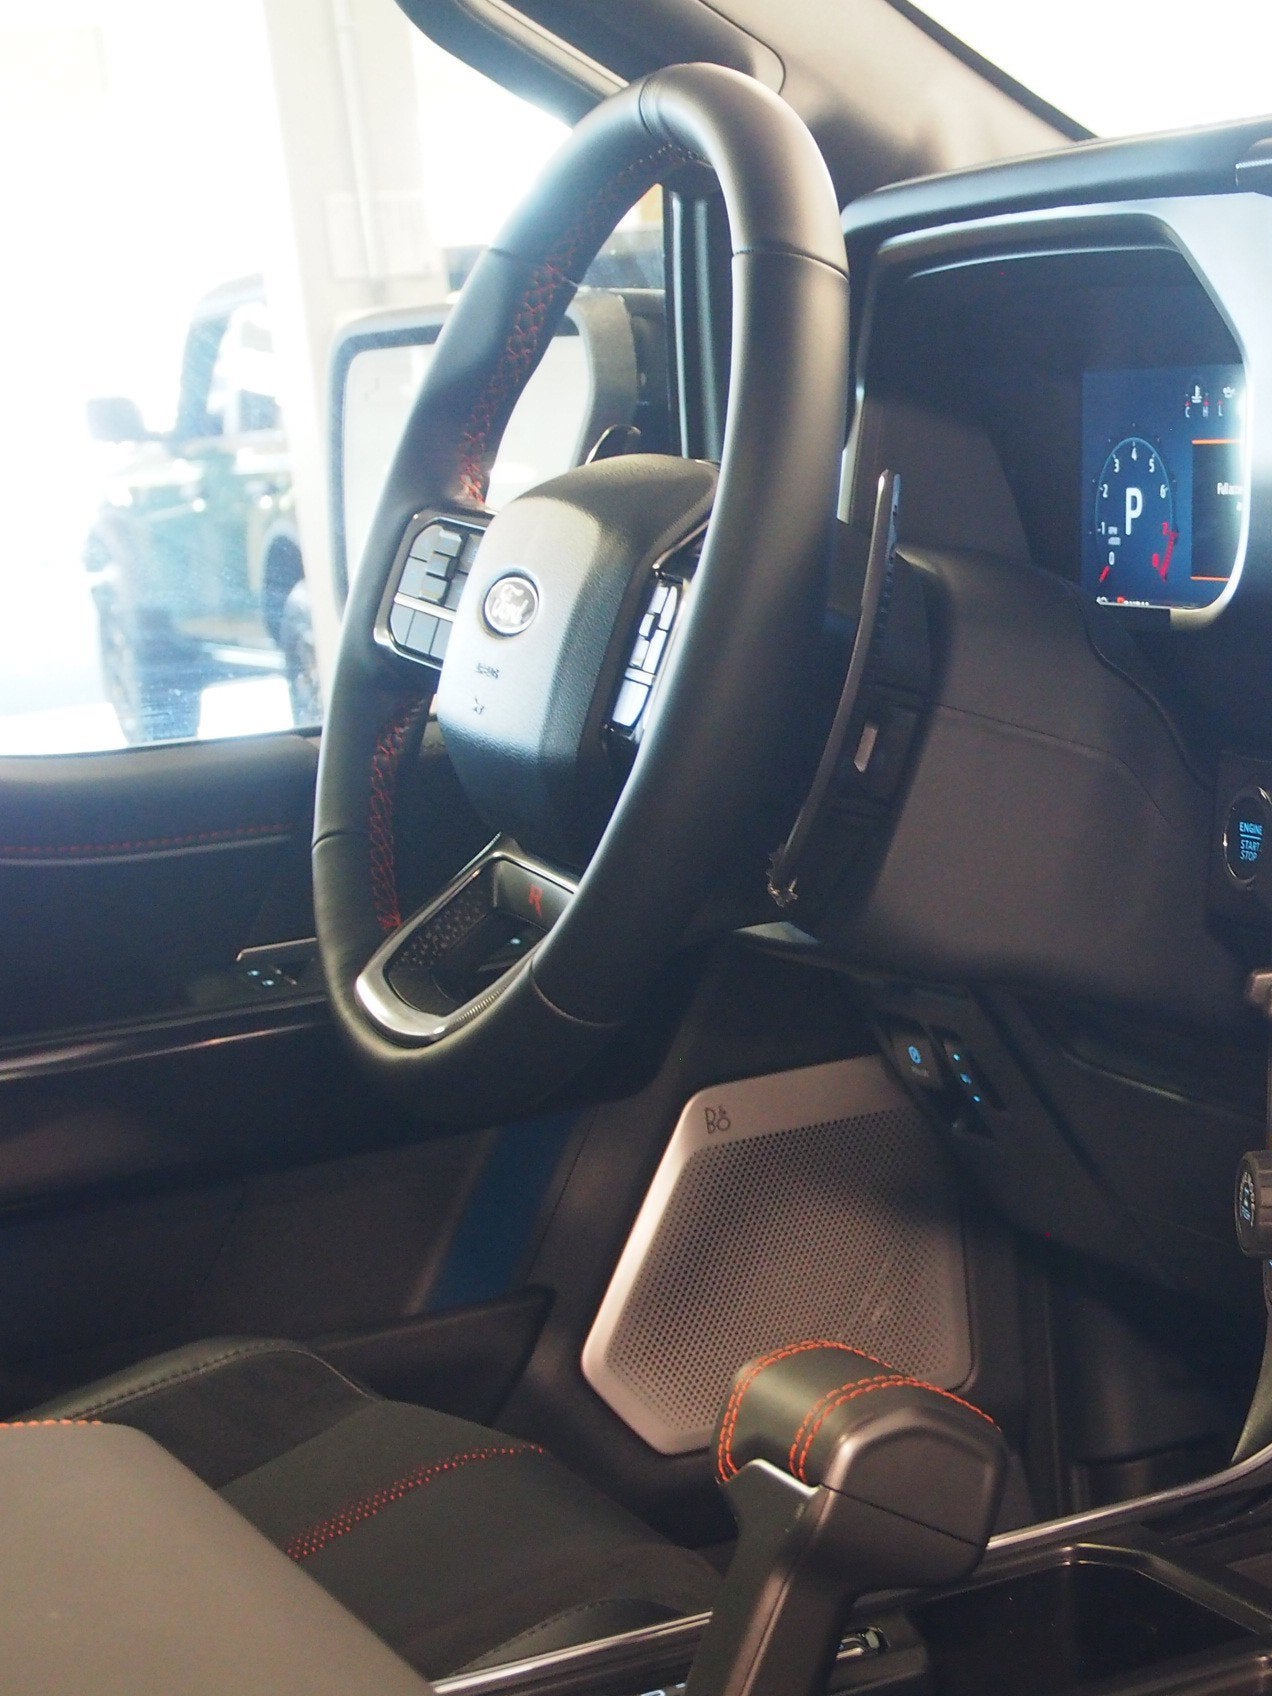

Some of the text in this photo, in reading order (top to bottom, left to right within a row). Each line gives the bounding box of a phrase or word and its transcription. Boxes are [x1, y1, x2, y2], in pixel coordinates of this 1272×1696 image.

[1125, 487, 1144, 536] P
[1239, 821, 1263, 836] ENGINE
[1240, 839, 1261, 852] START
[1240, 850, 1258, 862] STOP
